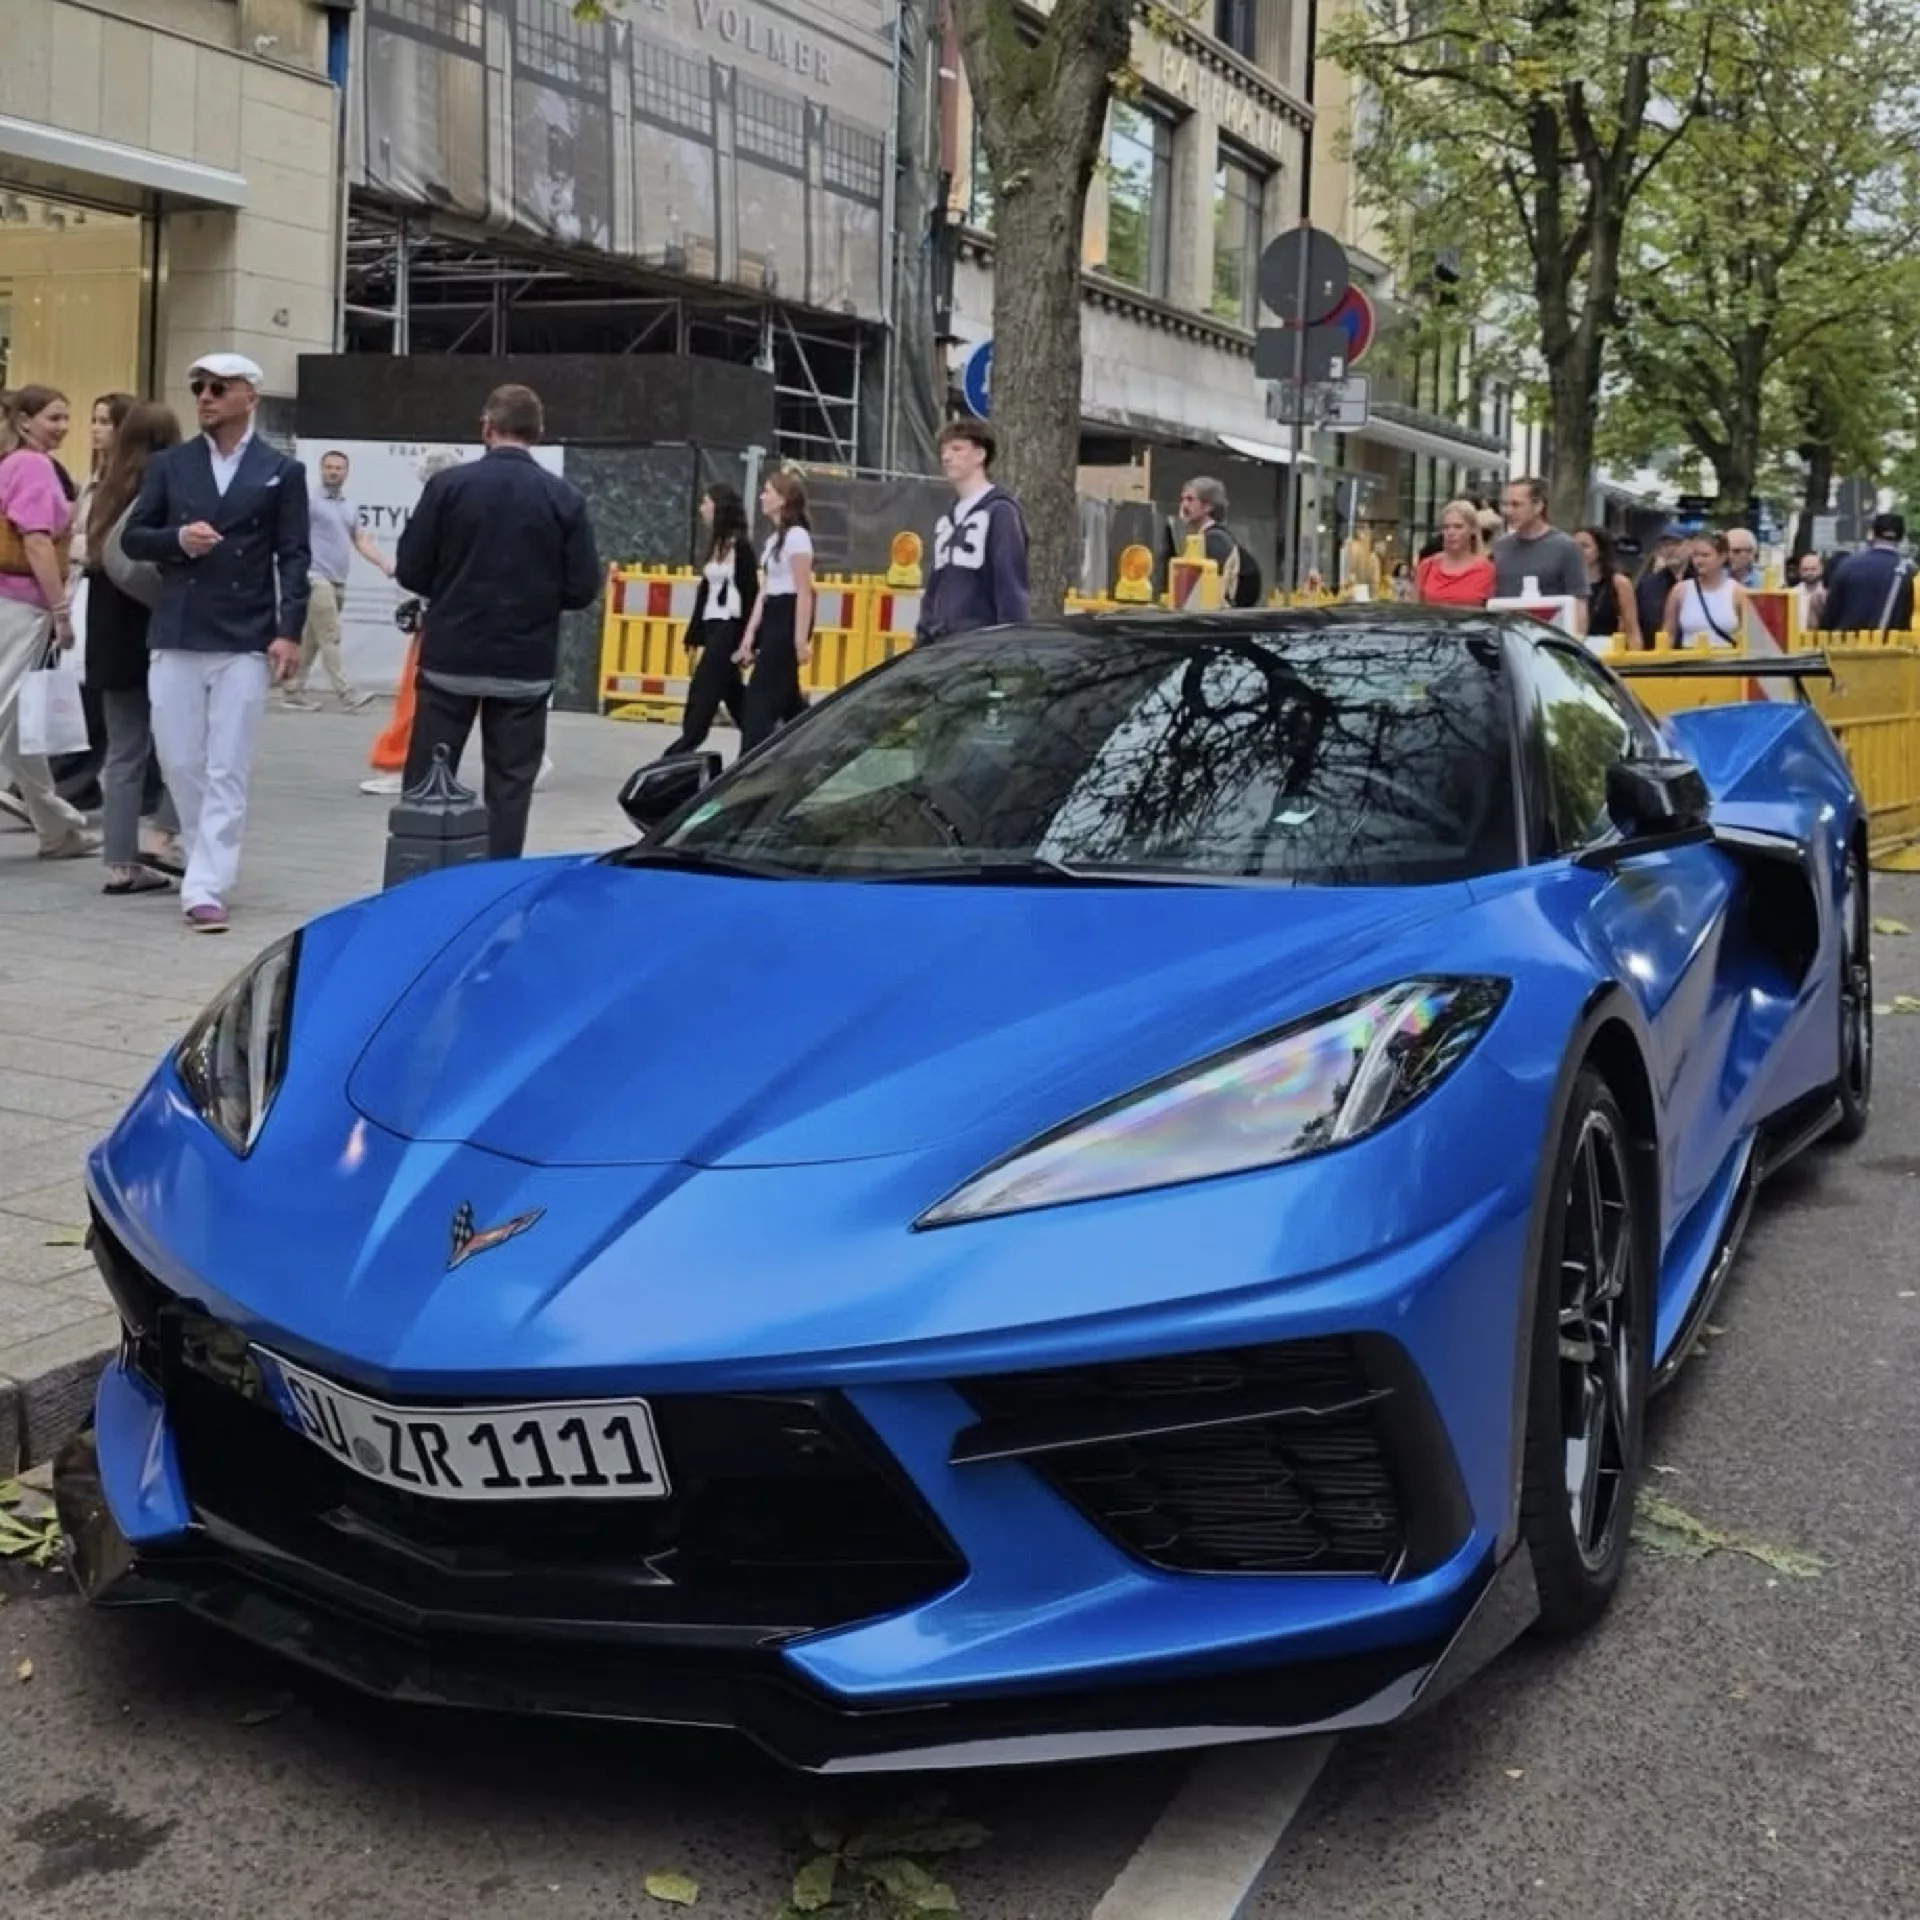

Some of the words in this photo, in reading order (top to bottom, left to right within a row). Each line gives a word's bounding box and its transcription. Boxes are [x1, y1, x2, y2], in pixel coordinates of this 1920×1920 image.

[934, 510, 990, 570] 23
[287, 1377, 353, 1458] SU
[373, 1415, 463, 1487] ZR
[468, 1416, 654, 1488] 1111
